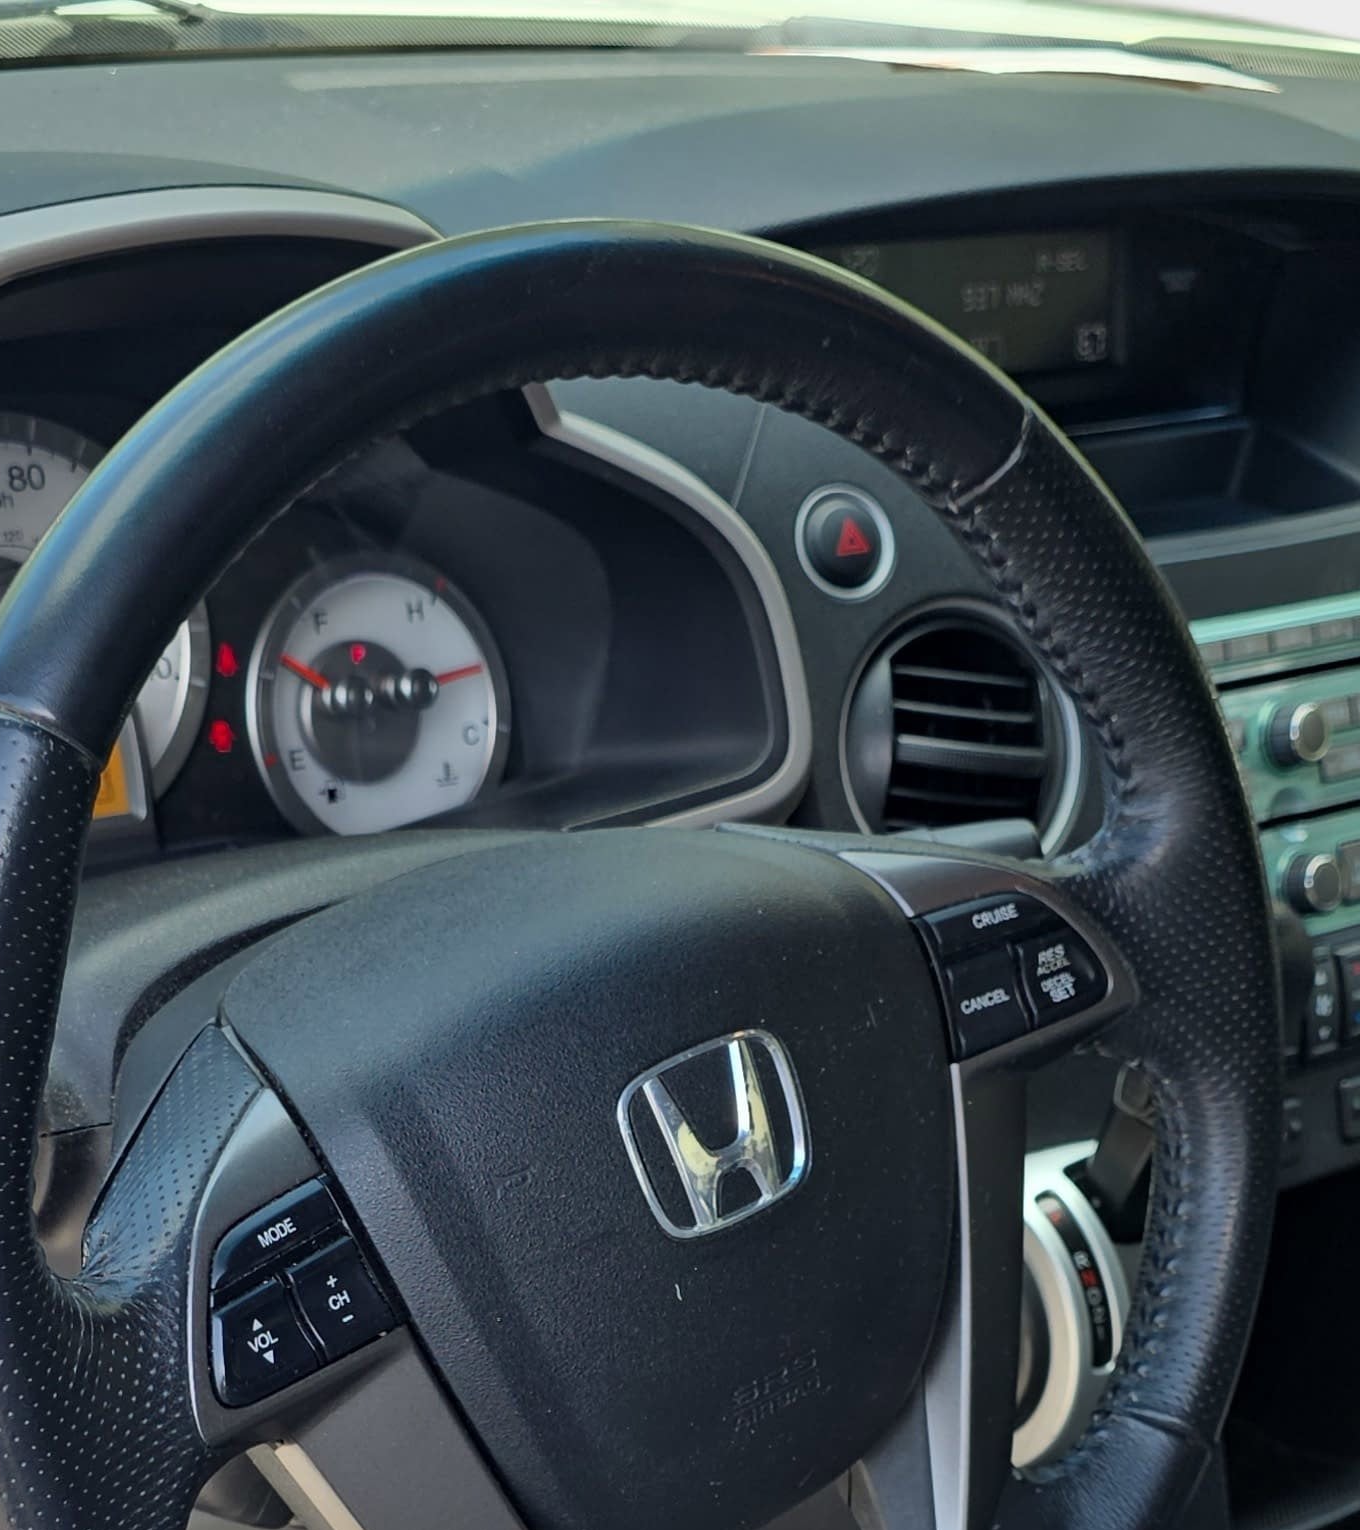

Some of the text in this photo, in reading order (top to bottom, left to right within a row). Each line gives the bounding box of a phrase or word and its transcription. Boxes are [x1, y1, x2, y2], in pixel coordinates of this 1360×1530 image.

[7, 464, 46, 493] 80
[314, 612, 328, 634] F
[407, 603, 424, 623] H
[463, 724, 480, 746] C
[290, 750, 306, 771] E
[971, 903, 1019, 929] CRUISE
[1037, 944, 1065, 965] RES
[960, 988, 1010, 1014] CANCEL
[1049, 982, 1076, 1003] SET
[257, 1217, 297, 1248] MODE
[328, 1290, 351, 1311] CH
[247, 1329, 279, 1353] VOL
